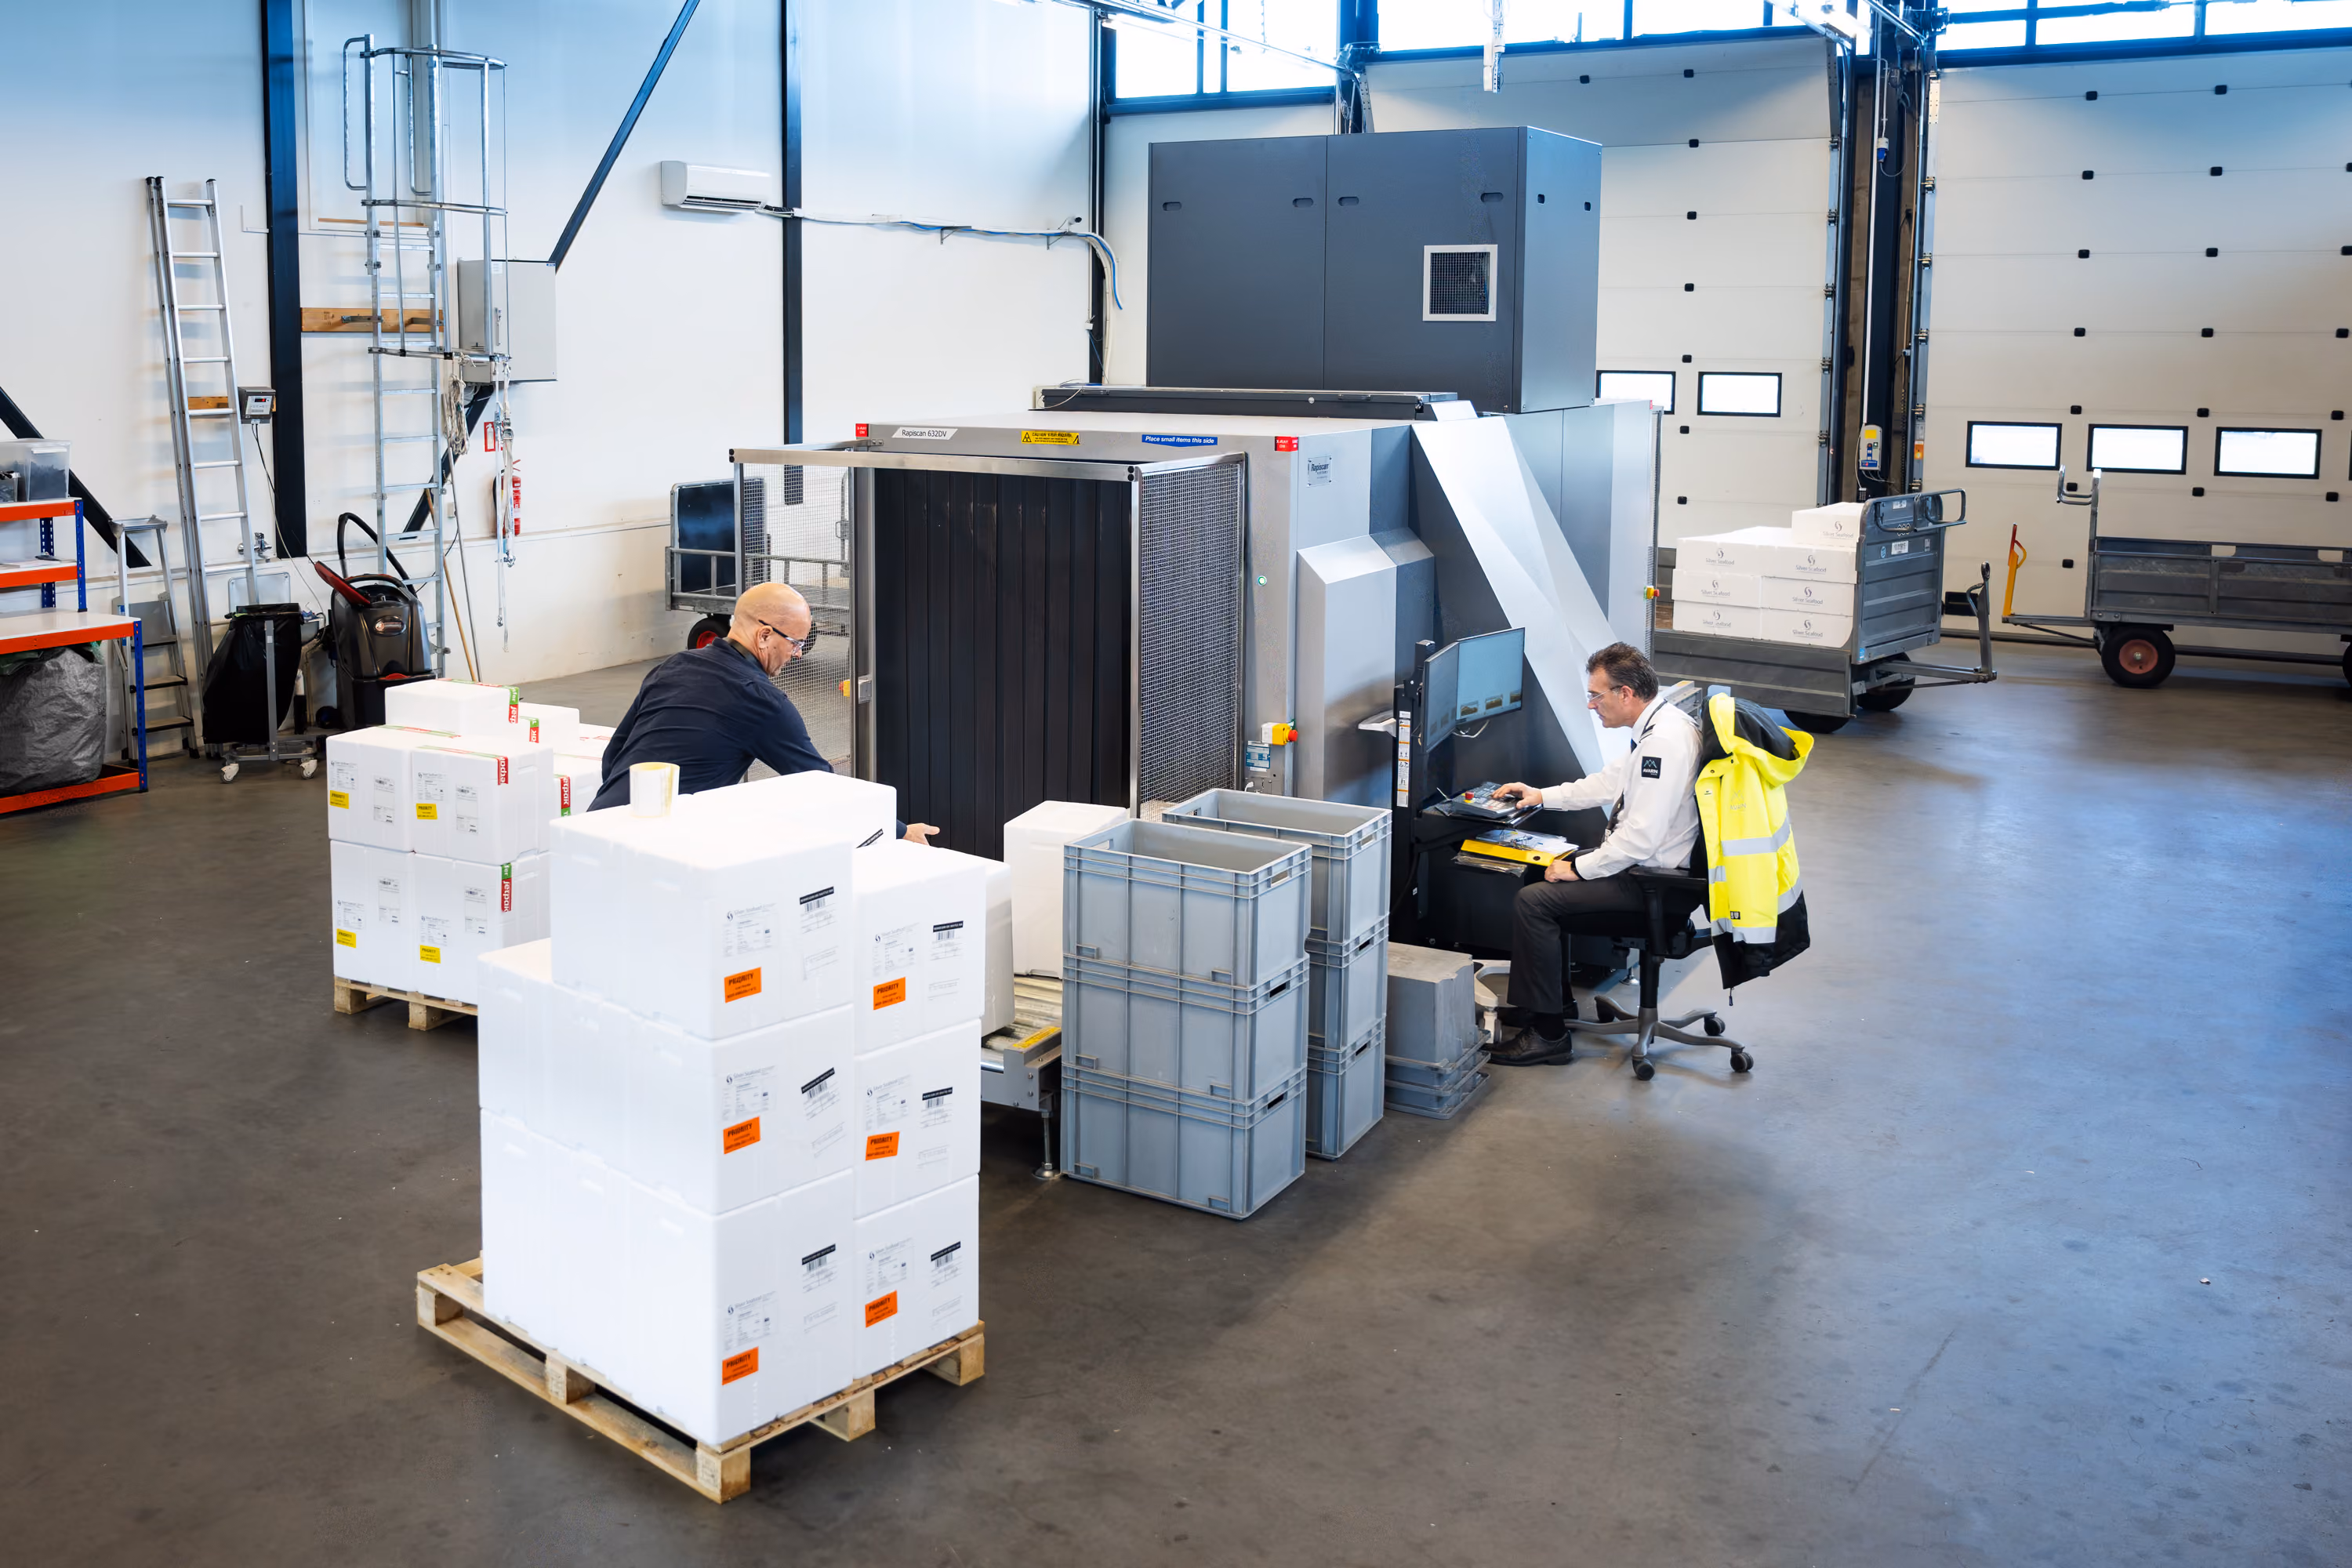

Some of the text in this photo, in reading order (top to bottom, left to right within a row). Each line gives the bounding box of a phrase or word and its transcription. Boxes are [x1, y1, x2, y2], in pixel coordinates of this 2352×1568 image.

[902, 429, 927, 437] Rapiscan
[1311, 463, 1330, 473] Rapiscan
[728, 972, 754, 986] PRIORITY
[877, 982, 899, 995] PRIORITY
[728, 1122, 753, 1138] PRIORITY
[870, 1136, 893, 1145] PRIORITY
[869, 1298, 891, 1312] PRIORITY
[726, 1353, 751, 1368] PRIORITY
